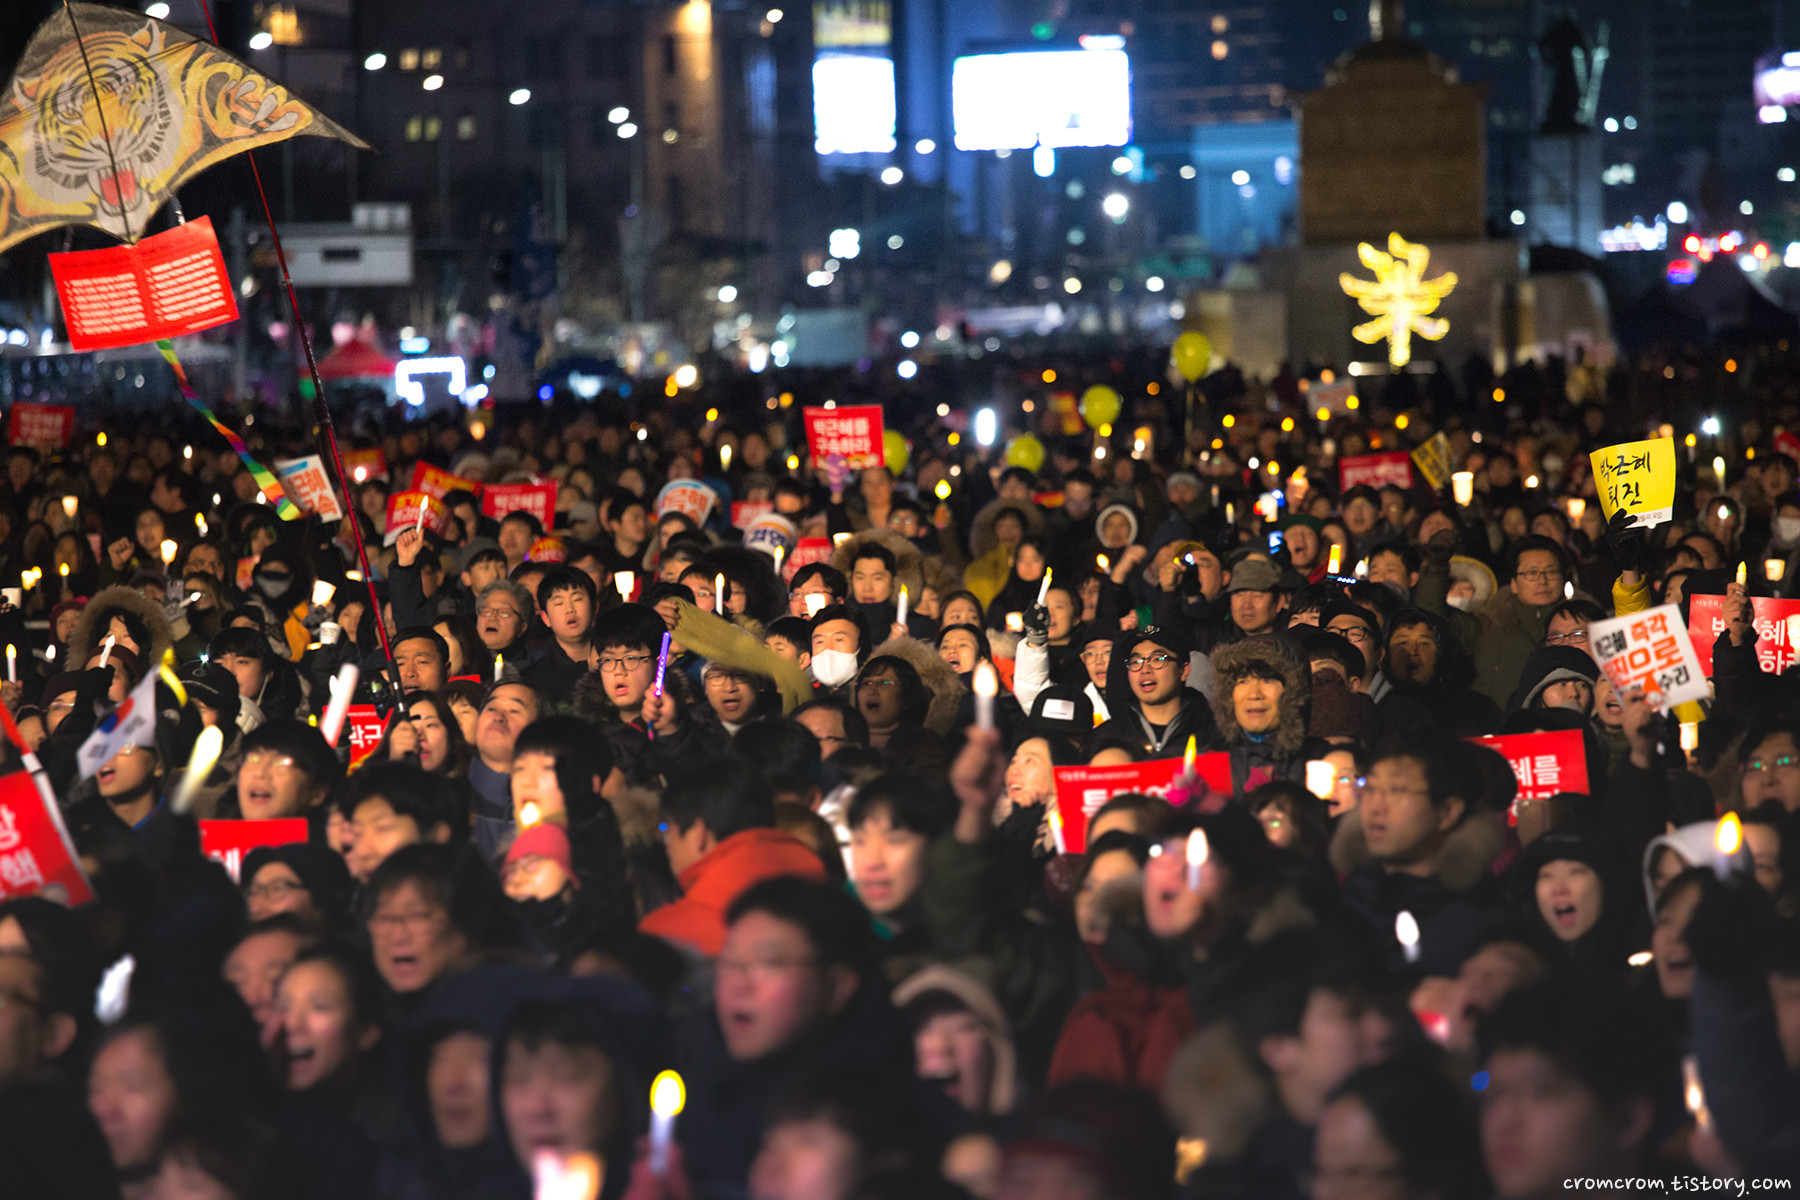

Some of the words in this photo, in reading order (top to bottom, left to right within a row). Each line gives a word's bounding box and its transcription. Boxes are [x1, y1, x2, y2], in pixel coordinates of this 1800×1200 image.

[1600, 451, 1651, 483] 박근혜
[1608, 482, 1642, 508] 퇴진
[1631, 613, 1669, 642] 즉각
